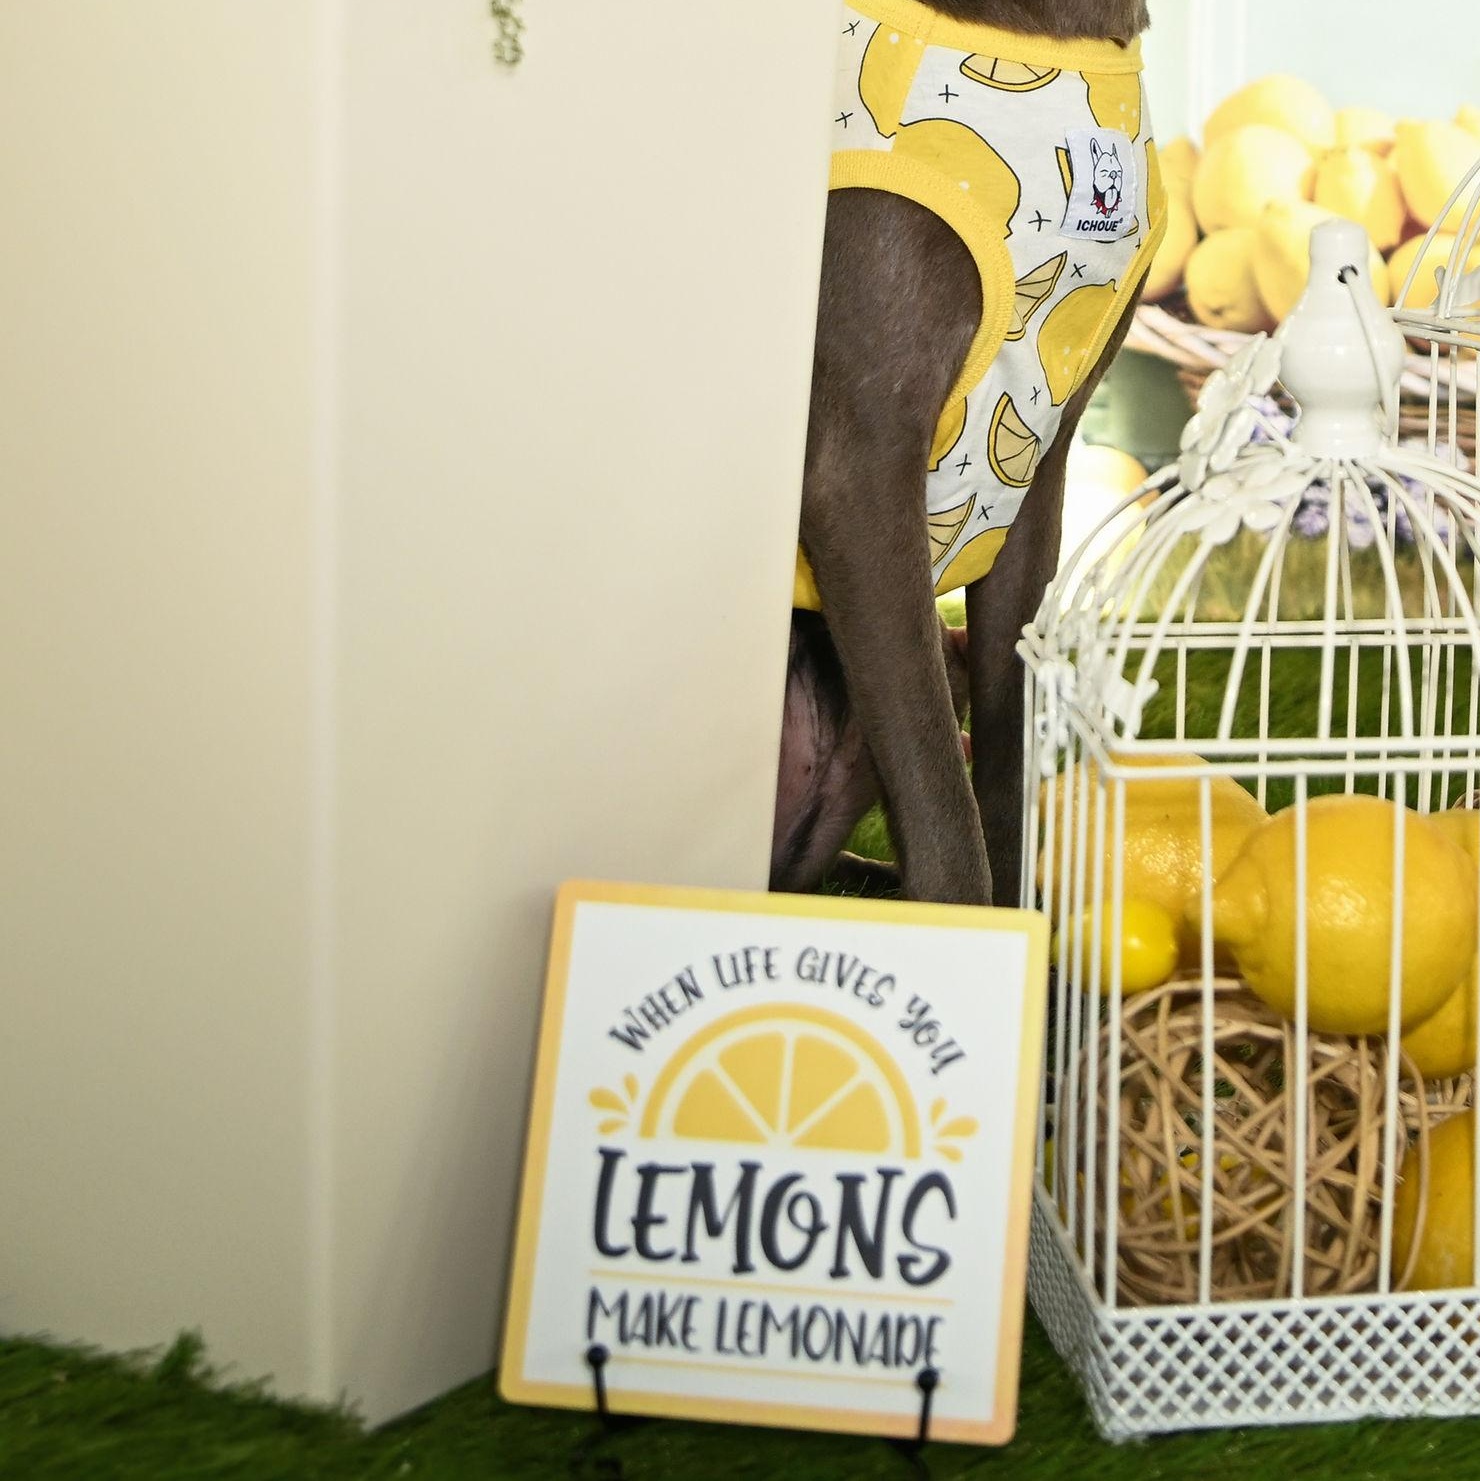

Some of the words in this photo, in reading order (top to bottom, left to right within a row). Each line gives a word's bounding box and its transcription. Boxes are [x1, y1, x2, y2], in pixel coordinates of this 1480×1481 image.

[608, 964, 705, 1053] WHEN
[711, 946, 782, 989] LIFE
[796, 946, 897, 1008] GIVES
[898, 992, 967, 1076] YOU
[592, 1146, 958, 1288] LEMONS
[586, 1285, 702, 1353] MAKE
[715, 1296, 945, 1370] LEMONADE
